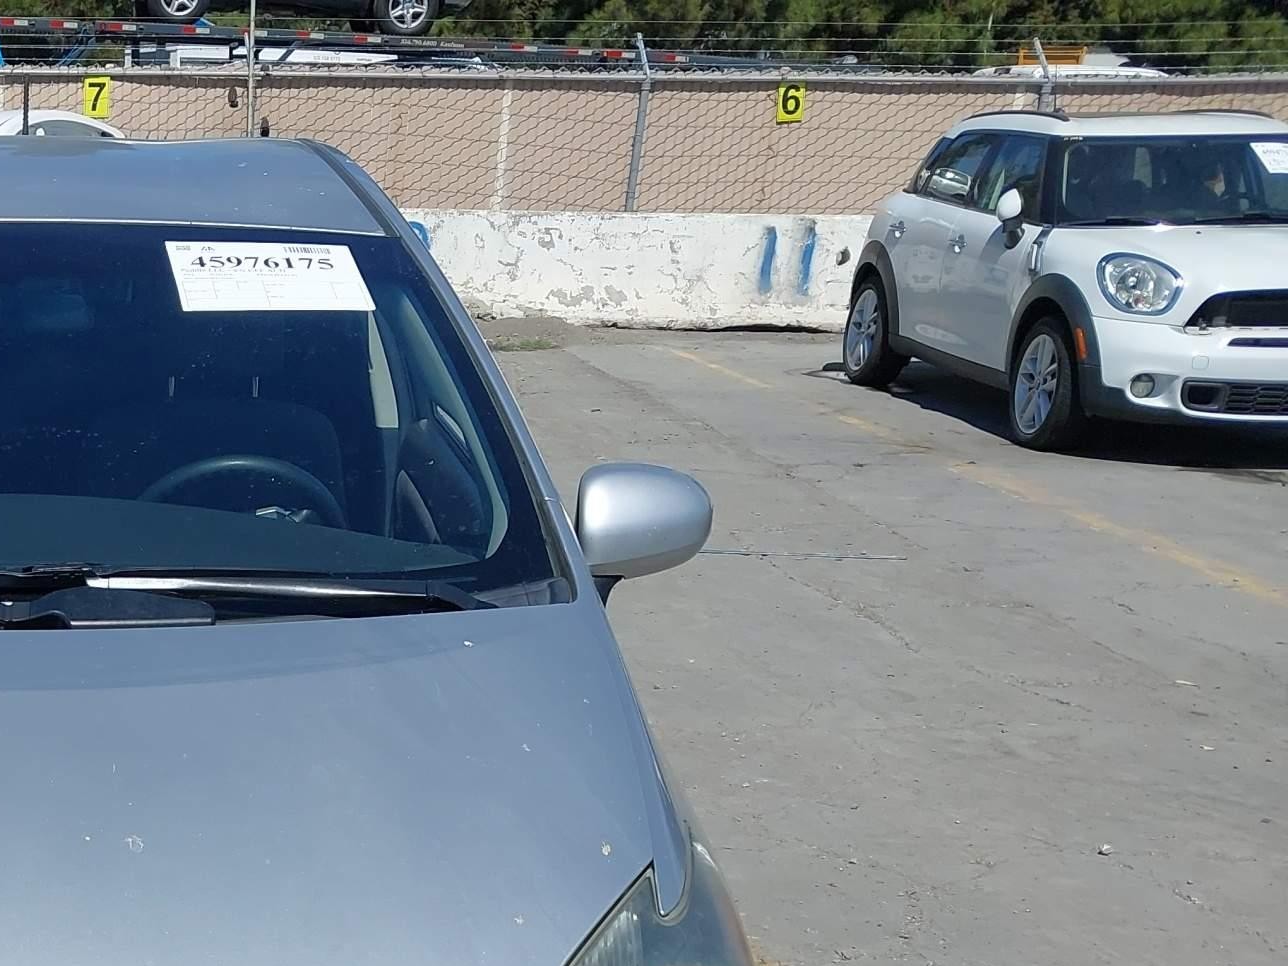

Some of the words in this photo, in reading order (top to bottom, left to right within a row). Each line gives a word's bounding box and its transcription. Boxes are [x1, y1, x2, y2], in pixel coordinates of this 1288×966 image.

[88, 82, 107, 112] 7
[782, 84, 801, 115] 6
[190, 255, 335, 270] 45976175
